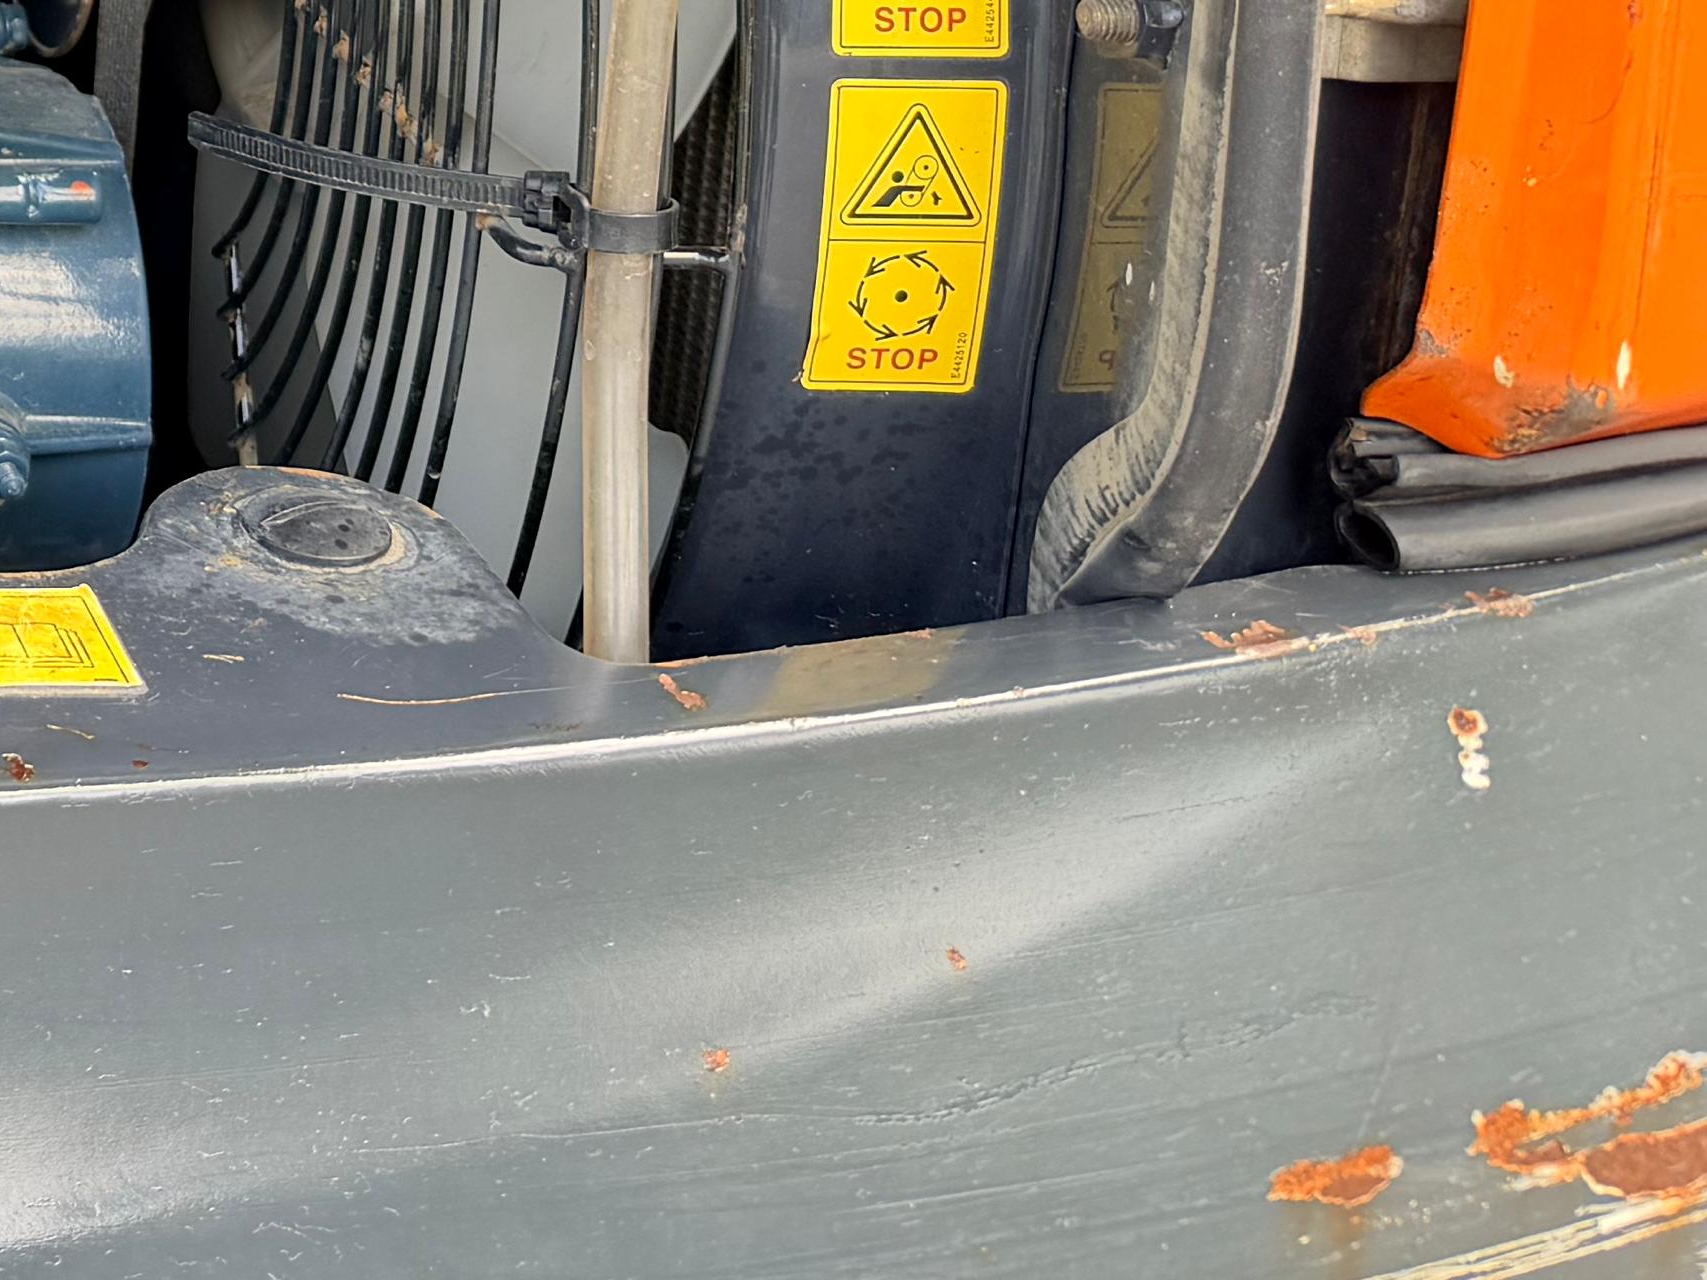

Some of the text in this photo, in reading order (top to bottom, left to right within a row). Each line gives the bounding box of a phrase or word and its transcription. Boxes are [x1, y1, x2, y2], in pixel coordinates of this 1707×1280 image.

[874, 6, 968, 34] STOP
[846, 347, 939, 371] STOP
[950, 331, 969, 380] E4425120
